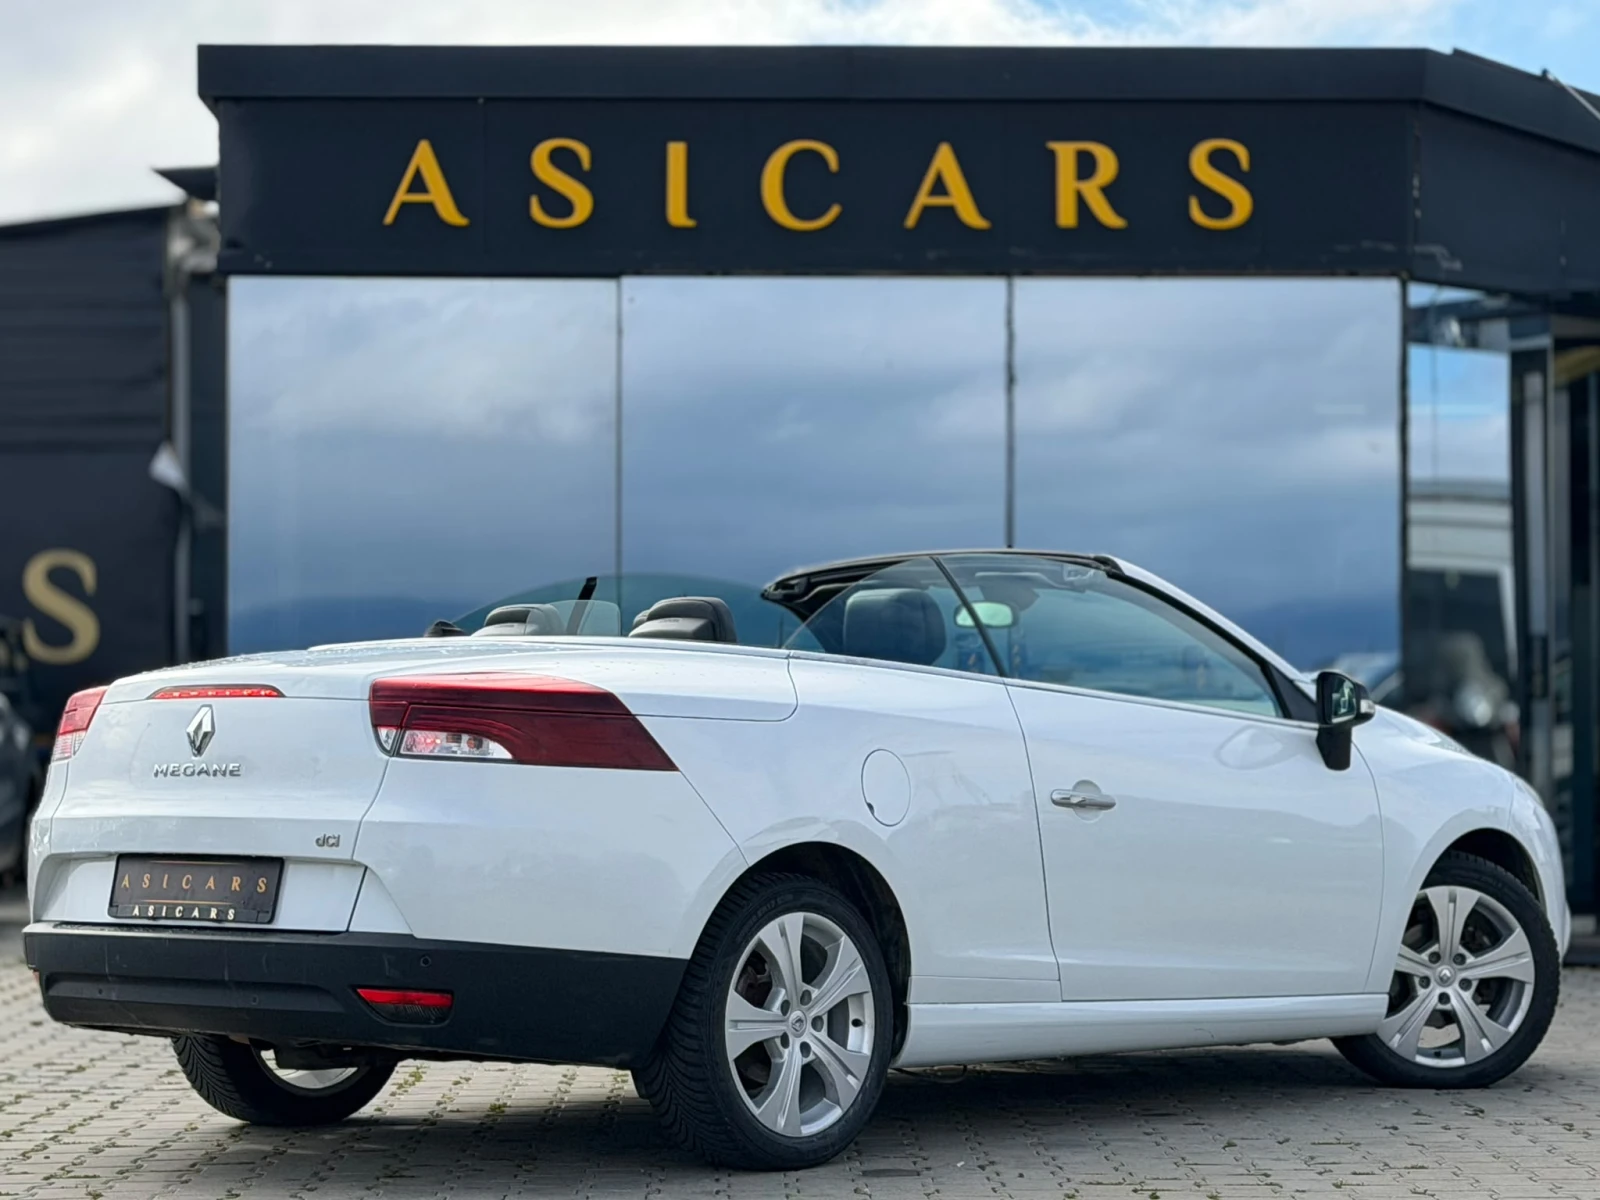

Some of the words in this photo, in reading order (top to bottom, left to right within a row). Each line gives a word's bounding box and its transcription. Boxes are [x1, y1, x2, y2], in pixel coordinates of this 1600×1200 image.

[383, 137, 1254, 231] ASICARS
[153, 763, 242, 778] MEGANE
[121, 873, 268, 893] ASICARS
[132, 905, 236, 920] ASICARS
